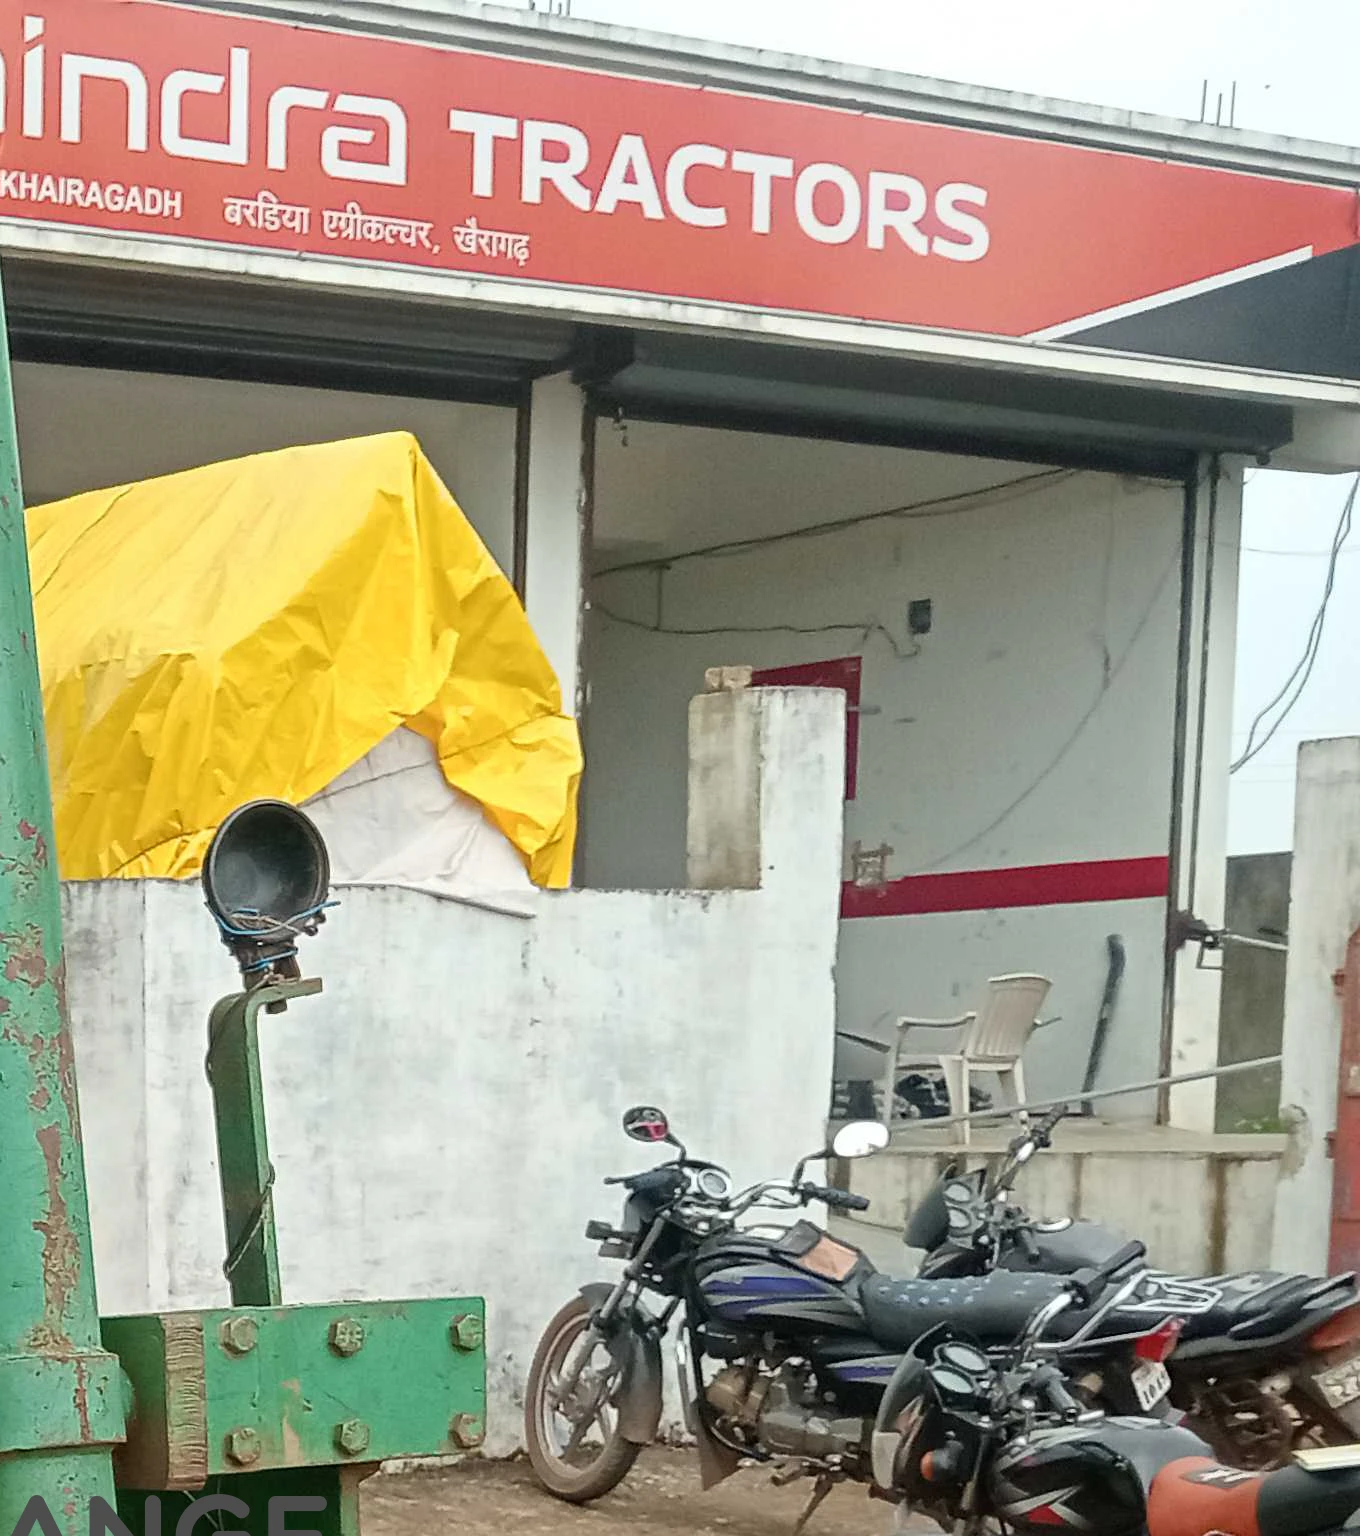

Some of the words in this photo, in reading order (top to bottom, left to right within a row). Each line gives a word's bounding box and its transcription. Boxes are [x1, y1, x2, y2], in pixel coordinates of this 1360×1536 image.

[223, 189, 310, 235] बरडिया
[452, 216, 530, 266] खैरागढ़
[448, 108, 991, 263] TRACTORS
